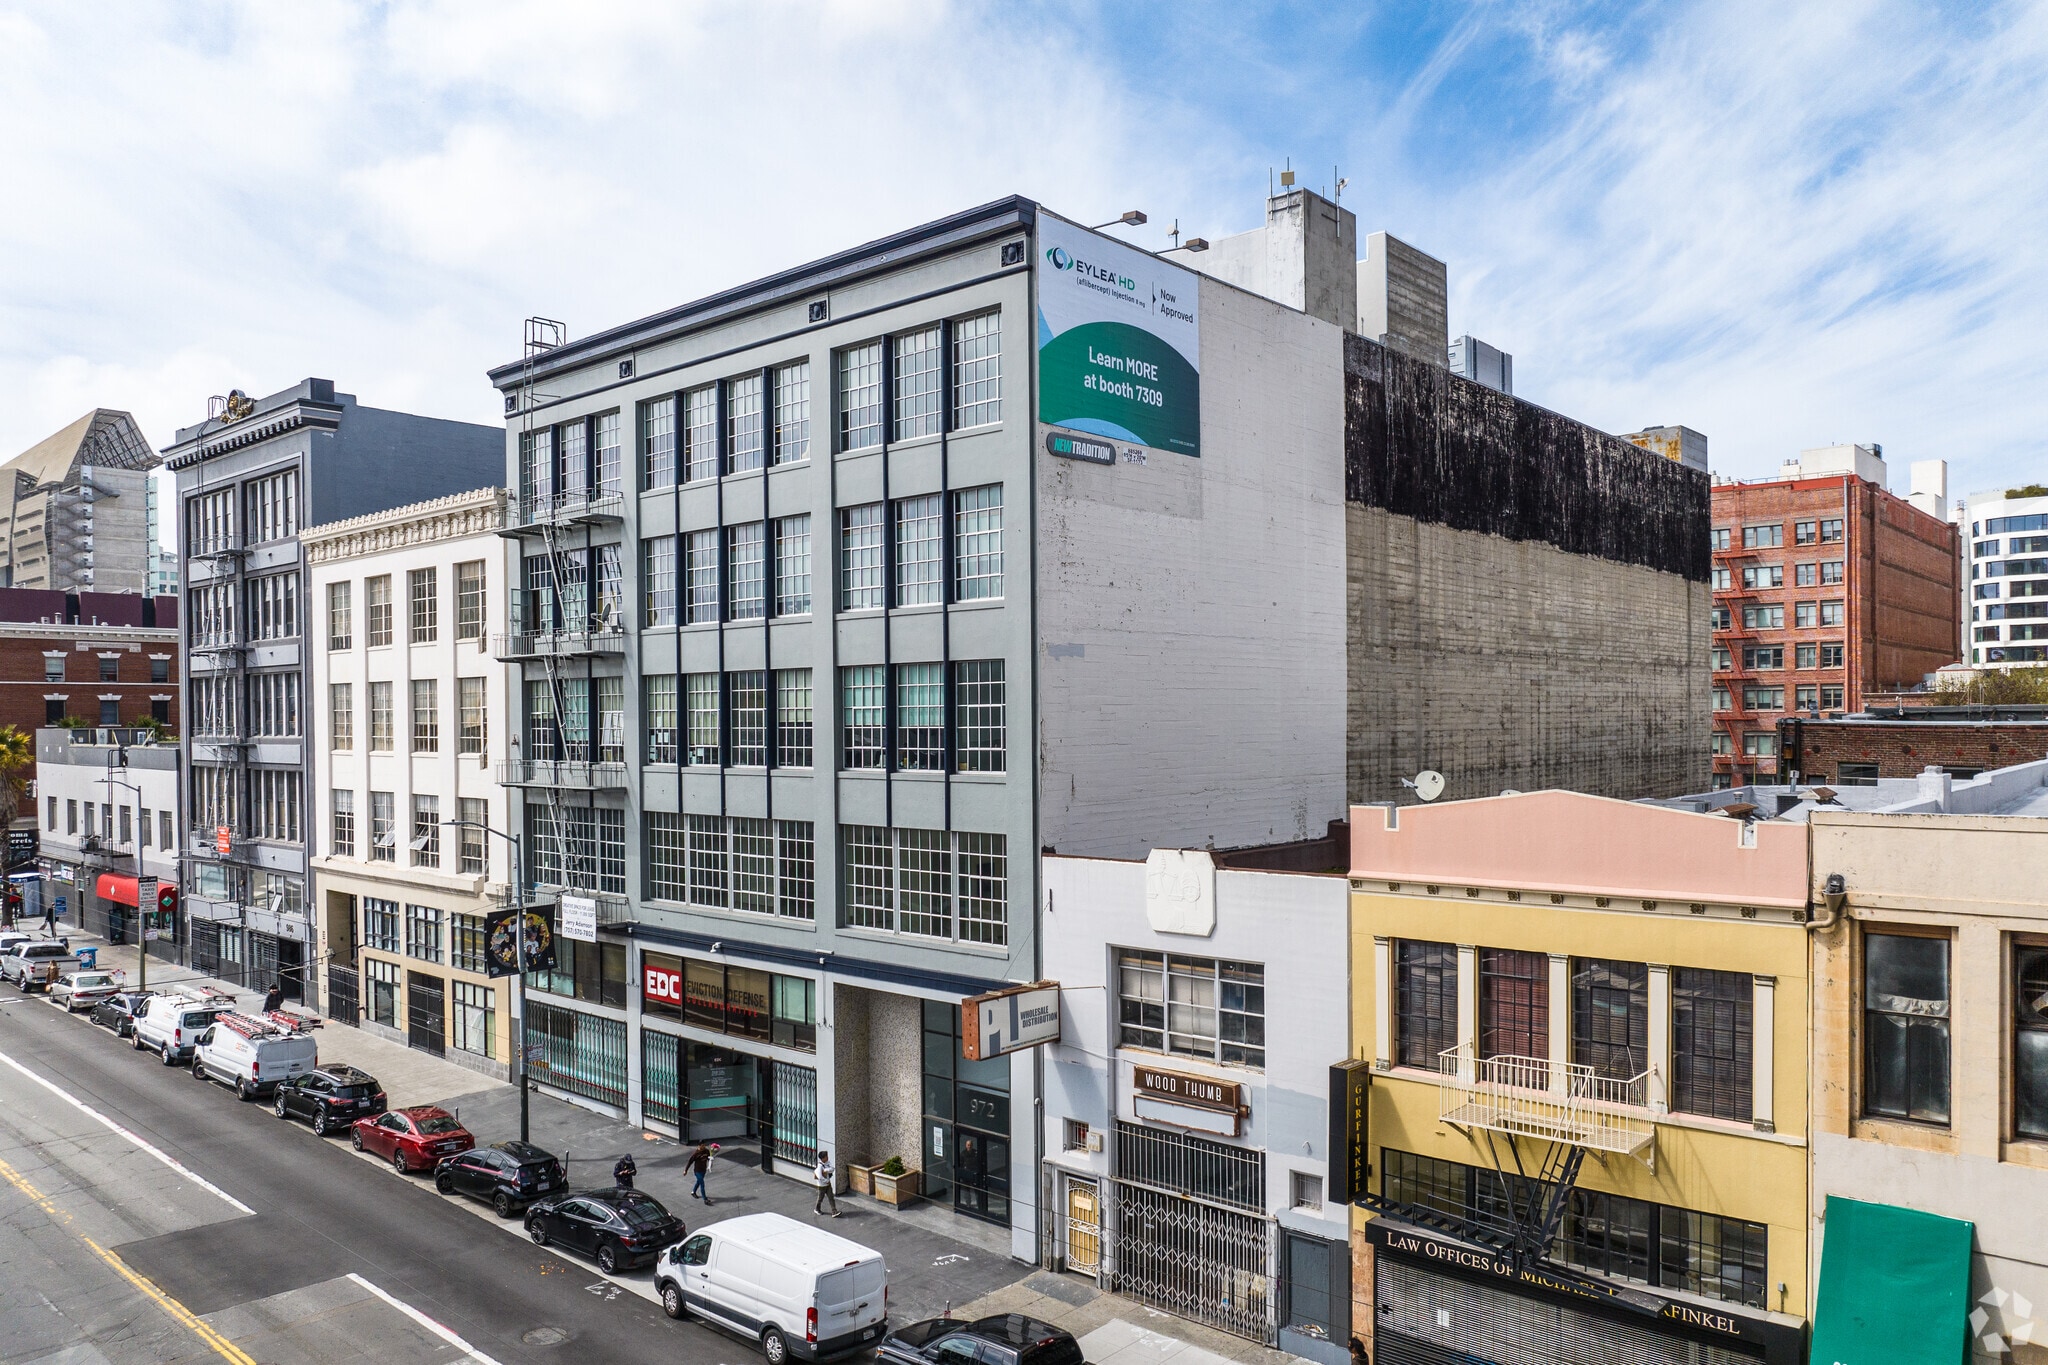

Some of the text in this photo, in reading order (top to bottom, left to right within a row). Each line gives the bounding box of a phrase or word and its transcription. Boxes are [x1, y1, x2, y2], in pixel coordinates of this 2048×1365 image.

[1076, 276, 1111, 296] (aflibercept)
[1118, 275, 1136, 291] HD
[1160, 288, 1176, 303] Now
[1160, 303, 1194, 323] Approved
[1089, 345, 1158, 382] Learn MORE
[1084, 374, 1163, 407] at booth 7309
[646, 969, 680, 1000] EDC
[687, 981, 765, 1008] EVICTION DEFENSE
[686, 995, 758, 1018] COLLABORATIVE
[1020, 1006, 1049, 1020] WHOLESALE
[1022, 1012, 1058, 1028] DISTRIBUTION
[1145, 1073, 1222, 1102] WOOD THUMB
[970, 1099, 995, 1118] 972
[1355, 1084, 1363, 1193] GURFINKEL
